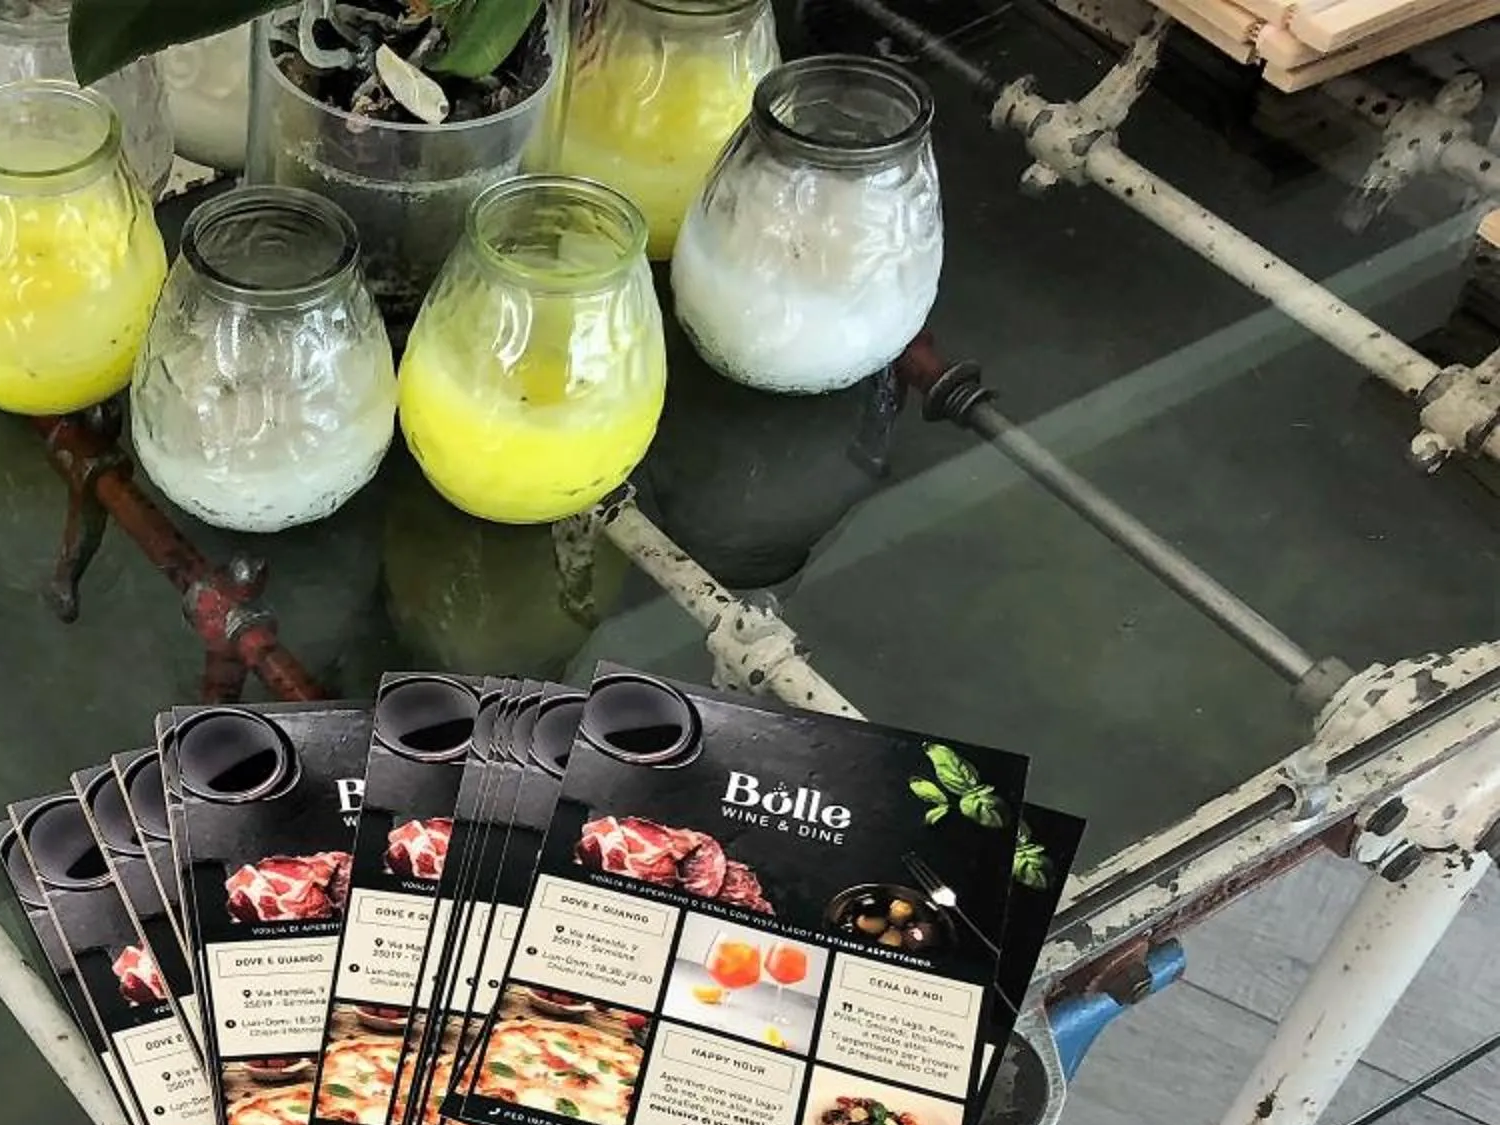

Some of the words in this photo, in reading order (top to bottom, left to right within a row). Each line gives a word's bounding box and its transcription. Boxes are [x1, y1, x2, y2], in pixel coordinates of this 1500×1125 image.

[700, 770, 852, 830] Bolle
[719, 804, 770, 827] WINE
[776, 818, 790, 832] &
[797, 824, 845, 845] DINE
[375, 907, 404, 919] DOVE
[560, 895, 589, 908] DOVE
[600, 904, 650, 924] QUANDO
[699, 902, 726, 915] CENA
[728, 910, 749, 921] CON
[235, 957, 263, 966] DOVE
[277, 954, 324, 965] QUANDO
[868, 976, 901, 992] CENA
[902, 985, 919, 996] DA
[921, 990, 943, 1002] NOI
[145, 1038, 173, 1050] DOVE
[690, 1047, 731, 1065] HAPPY
[732, 1059, 766, 1075] HOUR
[658, 1070, 706, 1091] Aperitivo
[706, 1084, 728, 1096] con
[728, 1089, 753, 1103] vista
[663, 1083, 679, 1095] Da
[700, 1093, 727, 1107] oltre
[502, 1110, 525, 1122] PER
[648, 1102, 699, 1122] esclusiva
[710, 1108, 731, 1120] una
